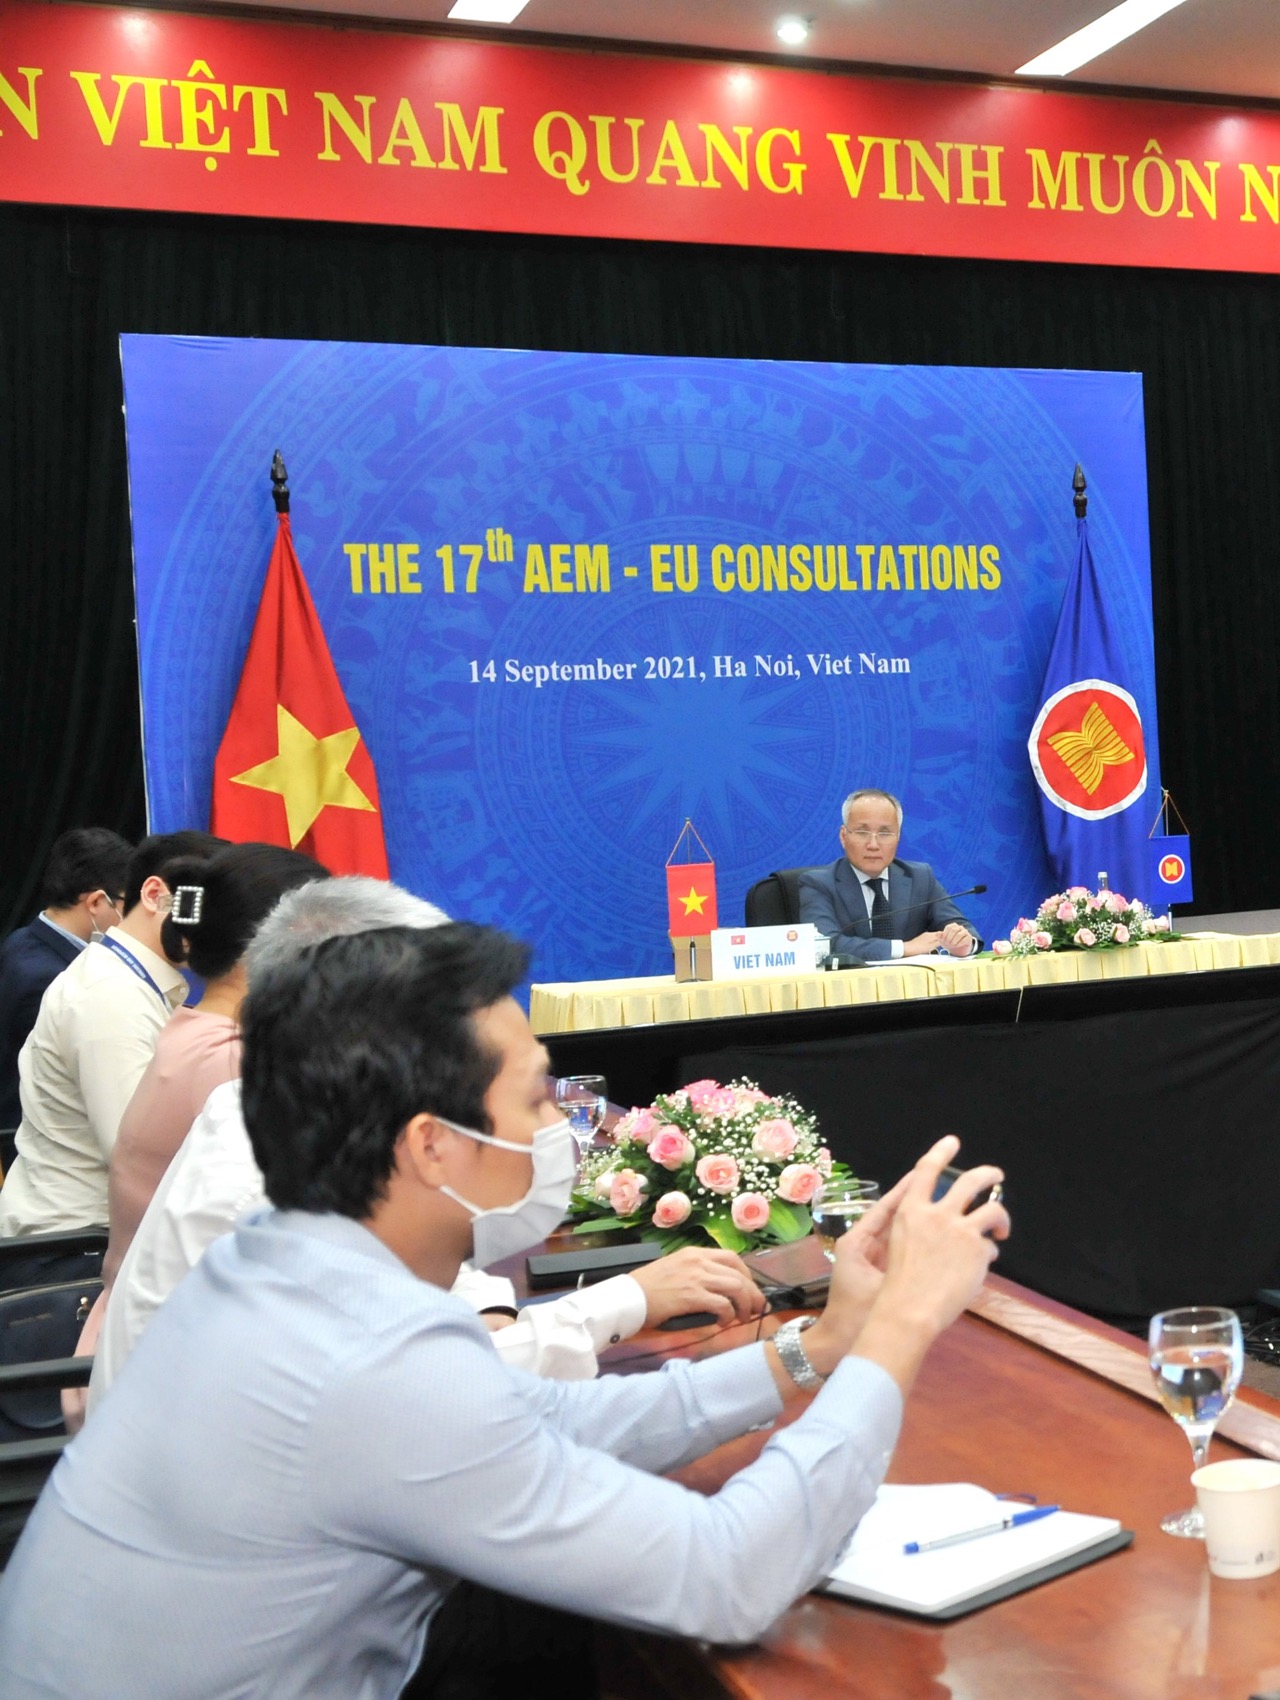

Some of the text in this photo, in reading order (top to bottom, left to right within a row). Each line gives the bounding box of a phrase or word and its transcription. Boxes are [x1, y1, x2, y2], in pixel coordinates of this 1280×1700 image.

[70, 60, 288, 171] VIỆT
[315, 92, 507, 174] NAM
[533, 109, 807, 196] QUANG
[826, 133, 1006, 206] VINH
[1025, 139, 1220, 219] MUÔN
[344, 543, 422, 594] THE
[436, 527, 514, 594] 17th
[524, 543, 611, 593] AEM
[651, 543, 699, 592] EU
[711, 543, 1001, 591] CONSULTATIONS
[468, 651, 911, 689] 14 September 2021, Ha Noi, Viet Nam
[733, 951, 795, 969] VIET NAM
